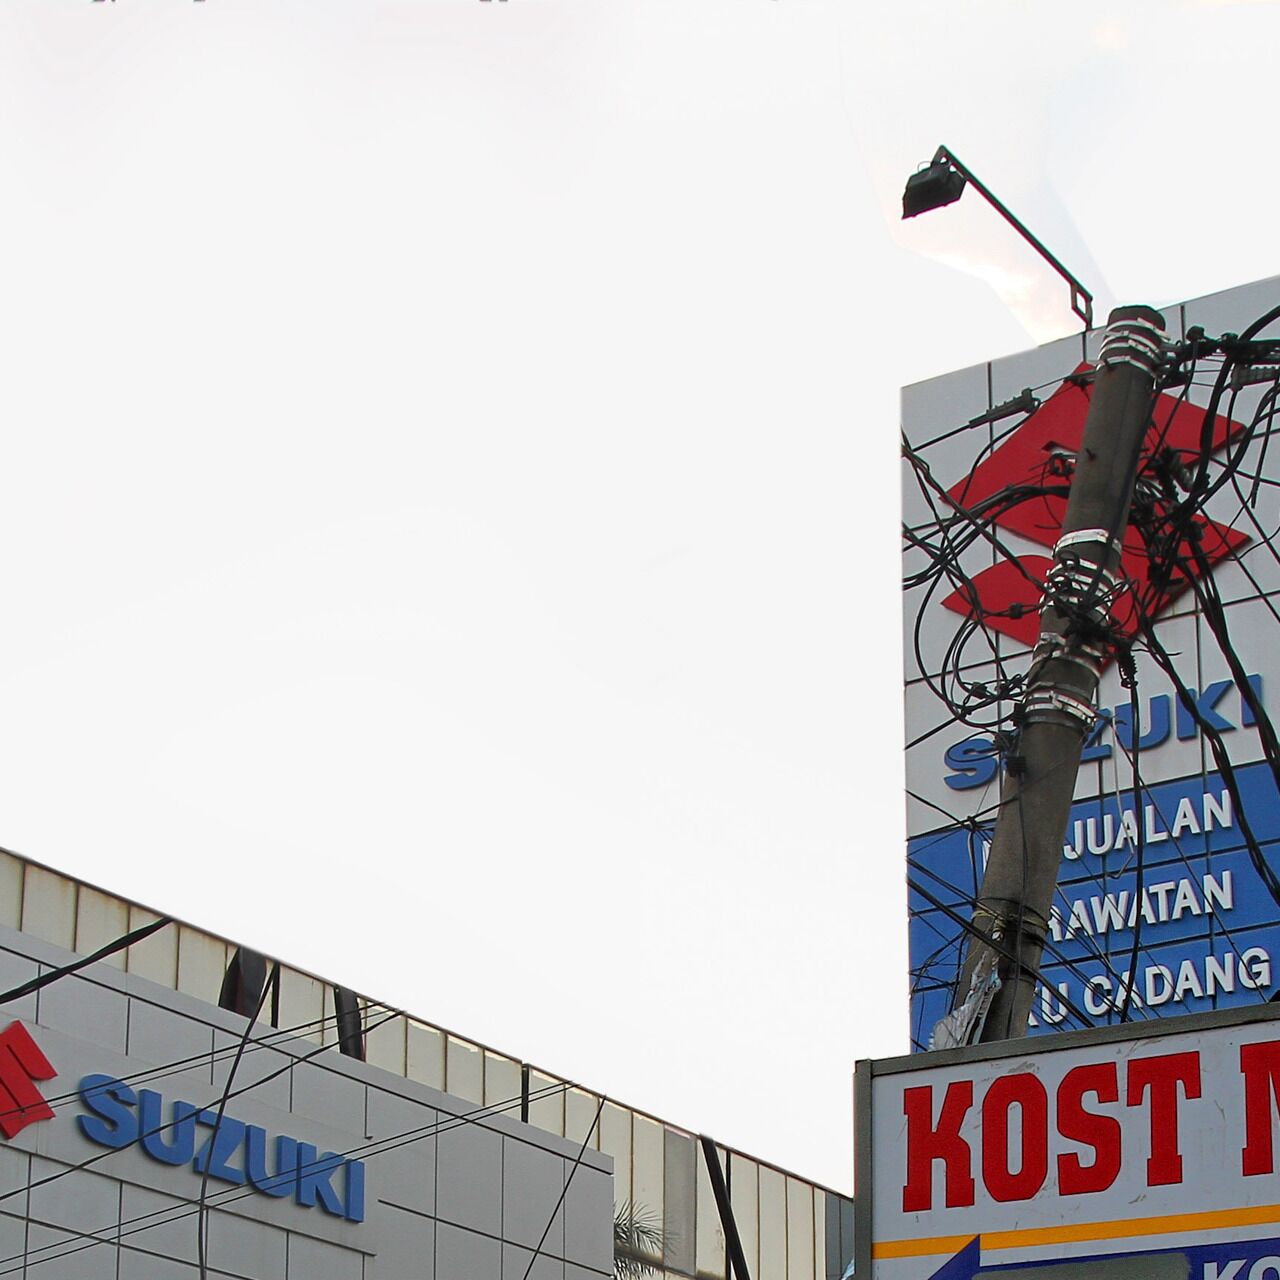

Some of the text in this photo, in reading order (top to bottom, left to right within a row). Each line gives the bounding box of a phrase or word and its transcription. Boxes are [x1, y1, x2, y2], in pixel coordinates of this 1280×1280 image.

[944, 674, 1262, 790] SZUKI
[1084, 947, 1272, 1016] CADANG
[77, 1073, 365, 1223] SUZUKI
[903, 1051, 1201, 1213] KOST
